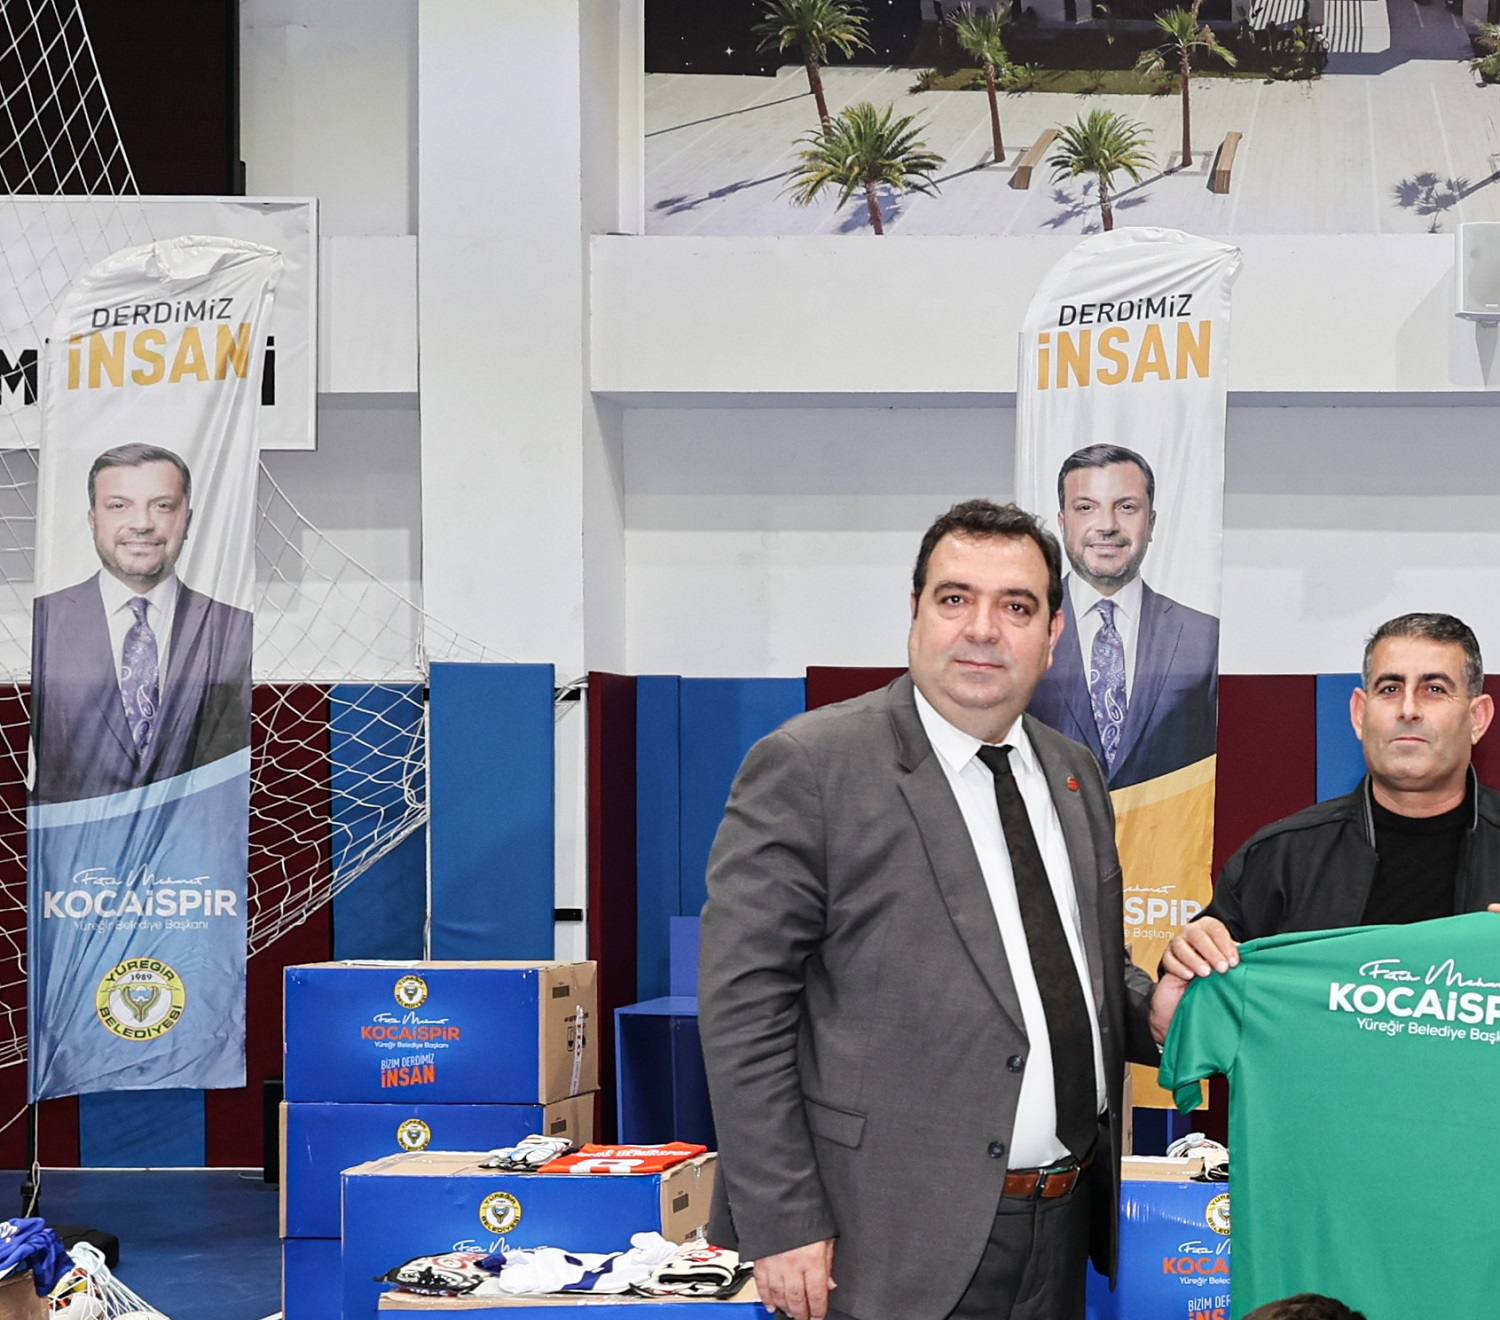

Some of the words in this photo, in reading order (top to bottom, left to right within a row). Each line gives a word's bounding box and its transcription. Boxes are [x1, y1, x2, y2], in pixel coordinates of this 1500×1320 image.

[165, 919, 209, 932] Başkanı
[1356, 1017, 1405, 1036] Yüreğir
[1408, 1022, 1466, 1041] Belediye
